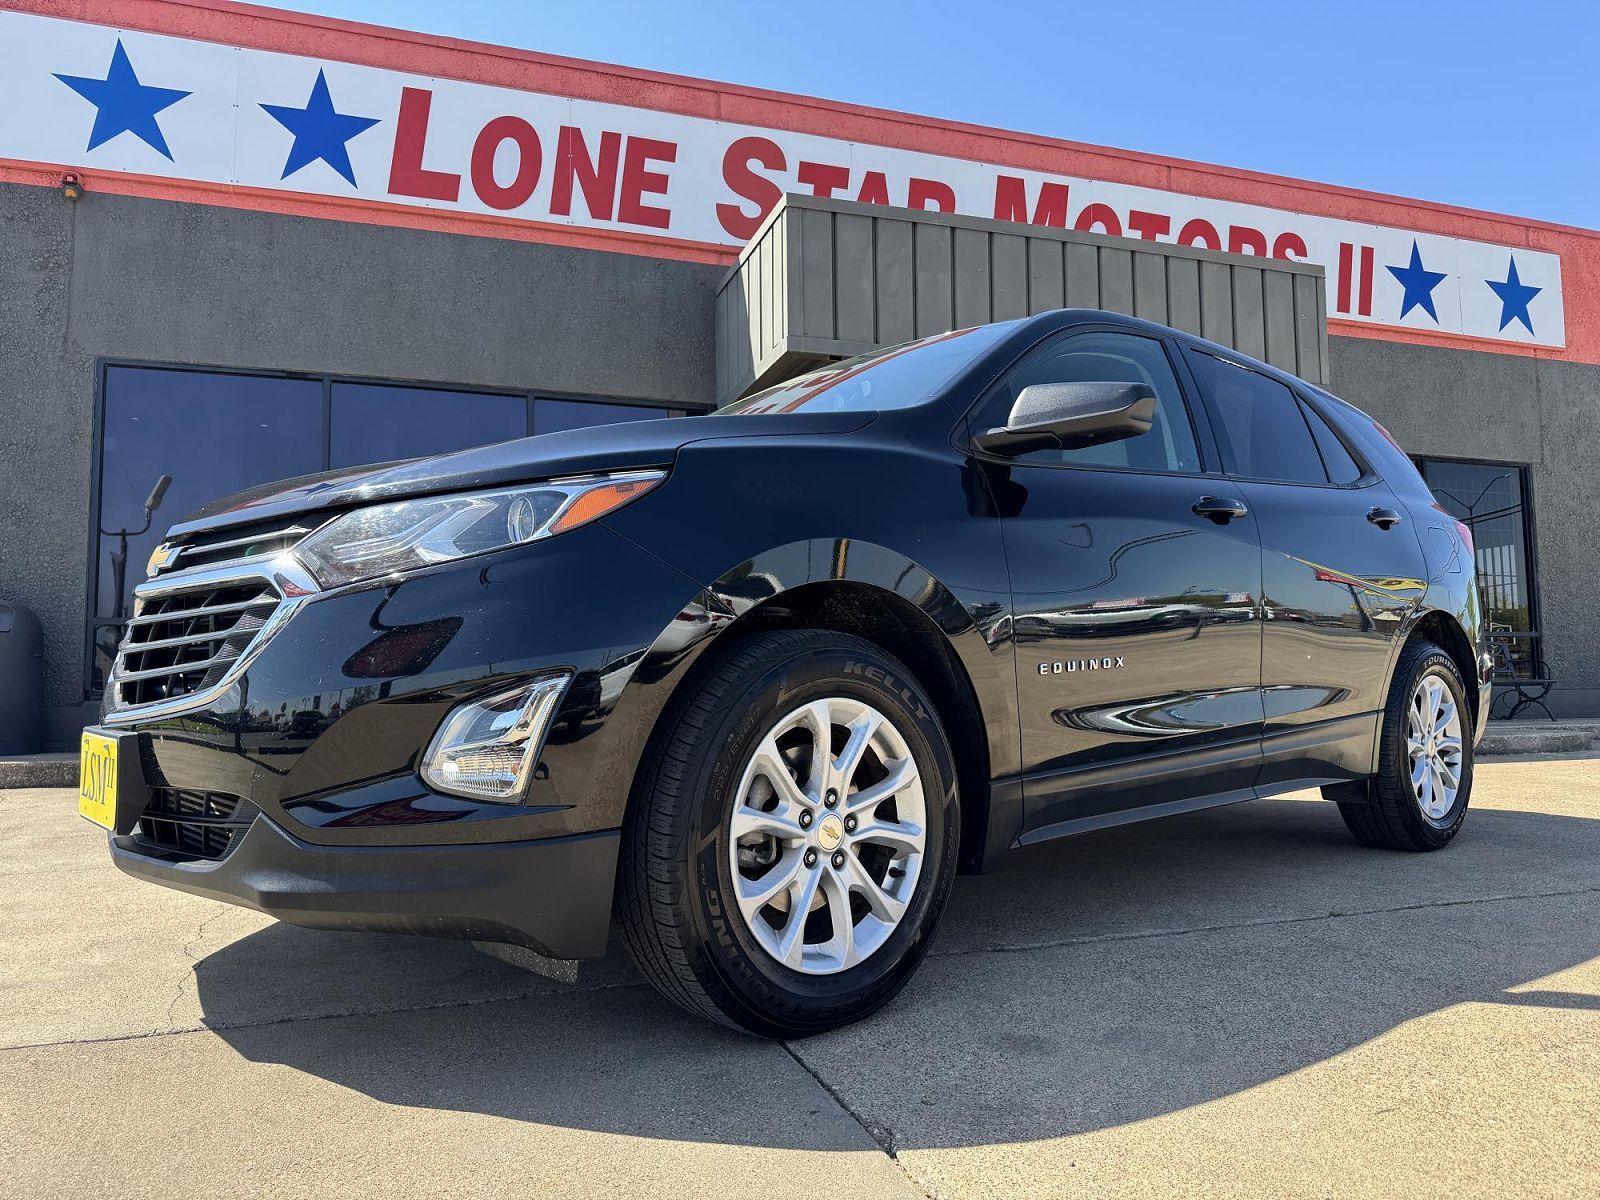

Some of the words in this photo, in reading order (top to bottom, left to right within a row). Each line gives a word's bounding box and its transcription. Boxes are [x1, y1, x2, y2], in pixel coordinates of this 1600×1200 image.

[387, 86, 678, 230] LONE
[1336, 242, 1375, 317] II
[843, 659, 931, 721] KELLY
[1038, 656, 1125, 675] EQUINOX
